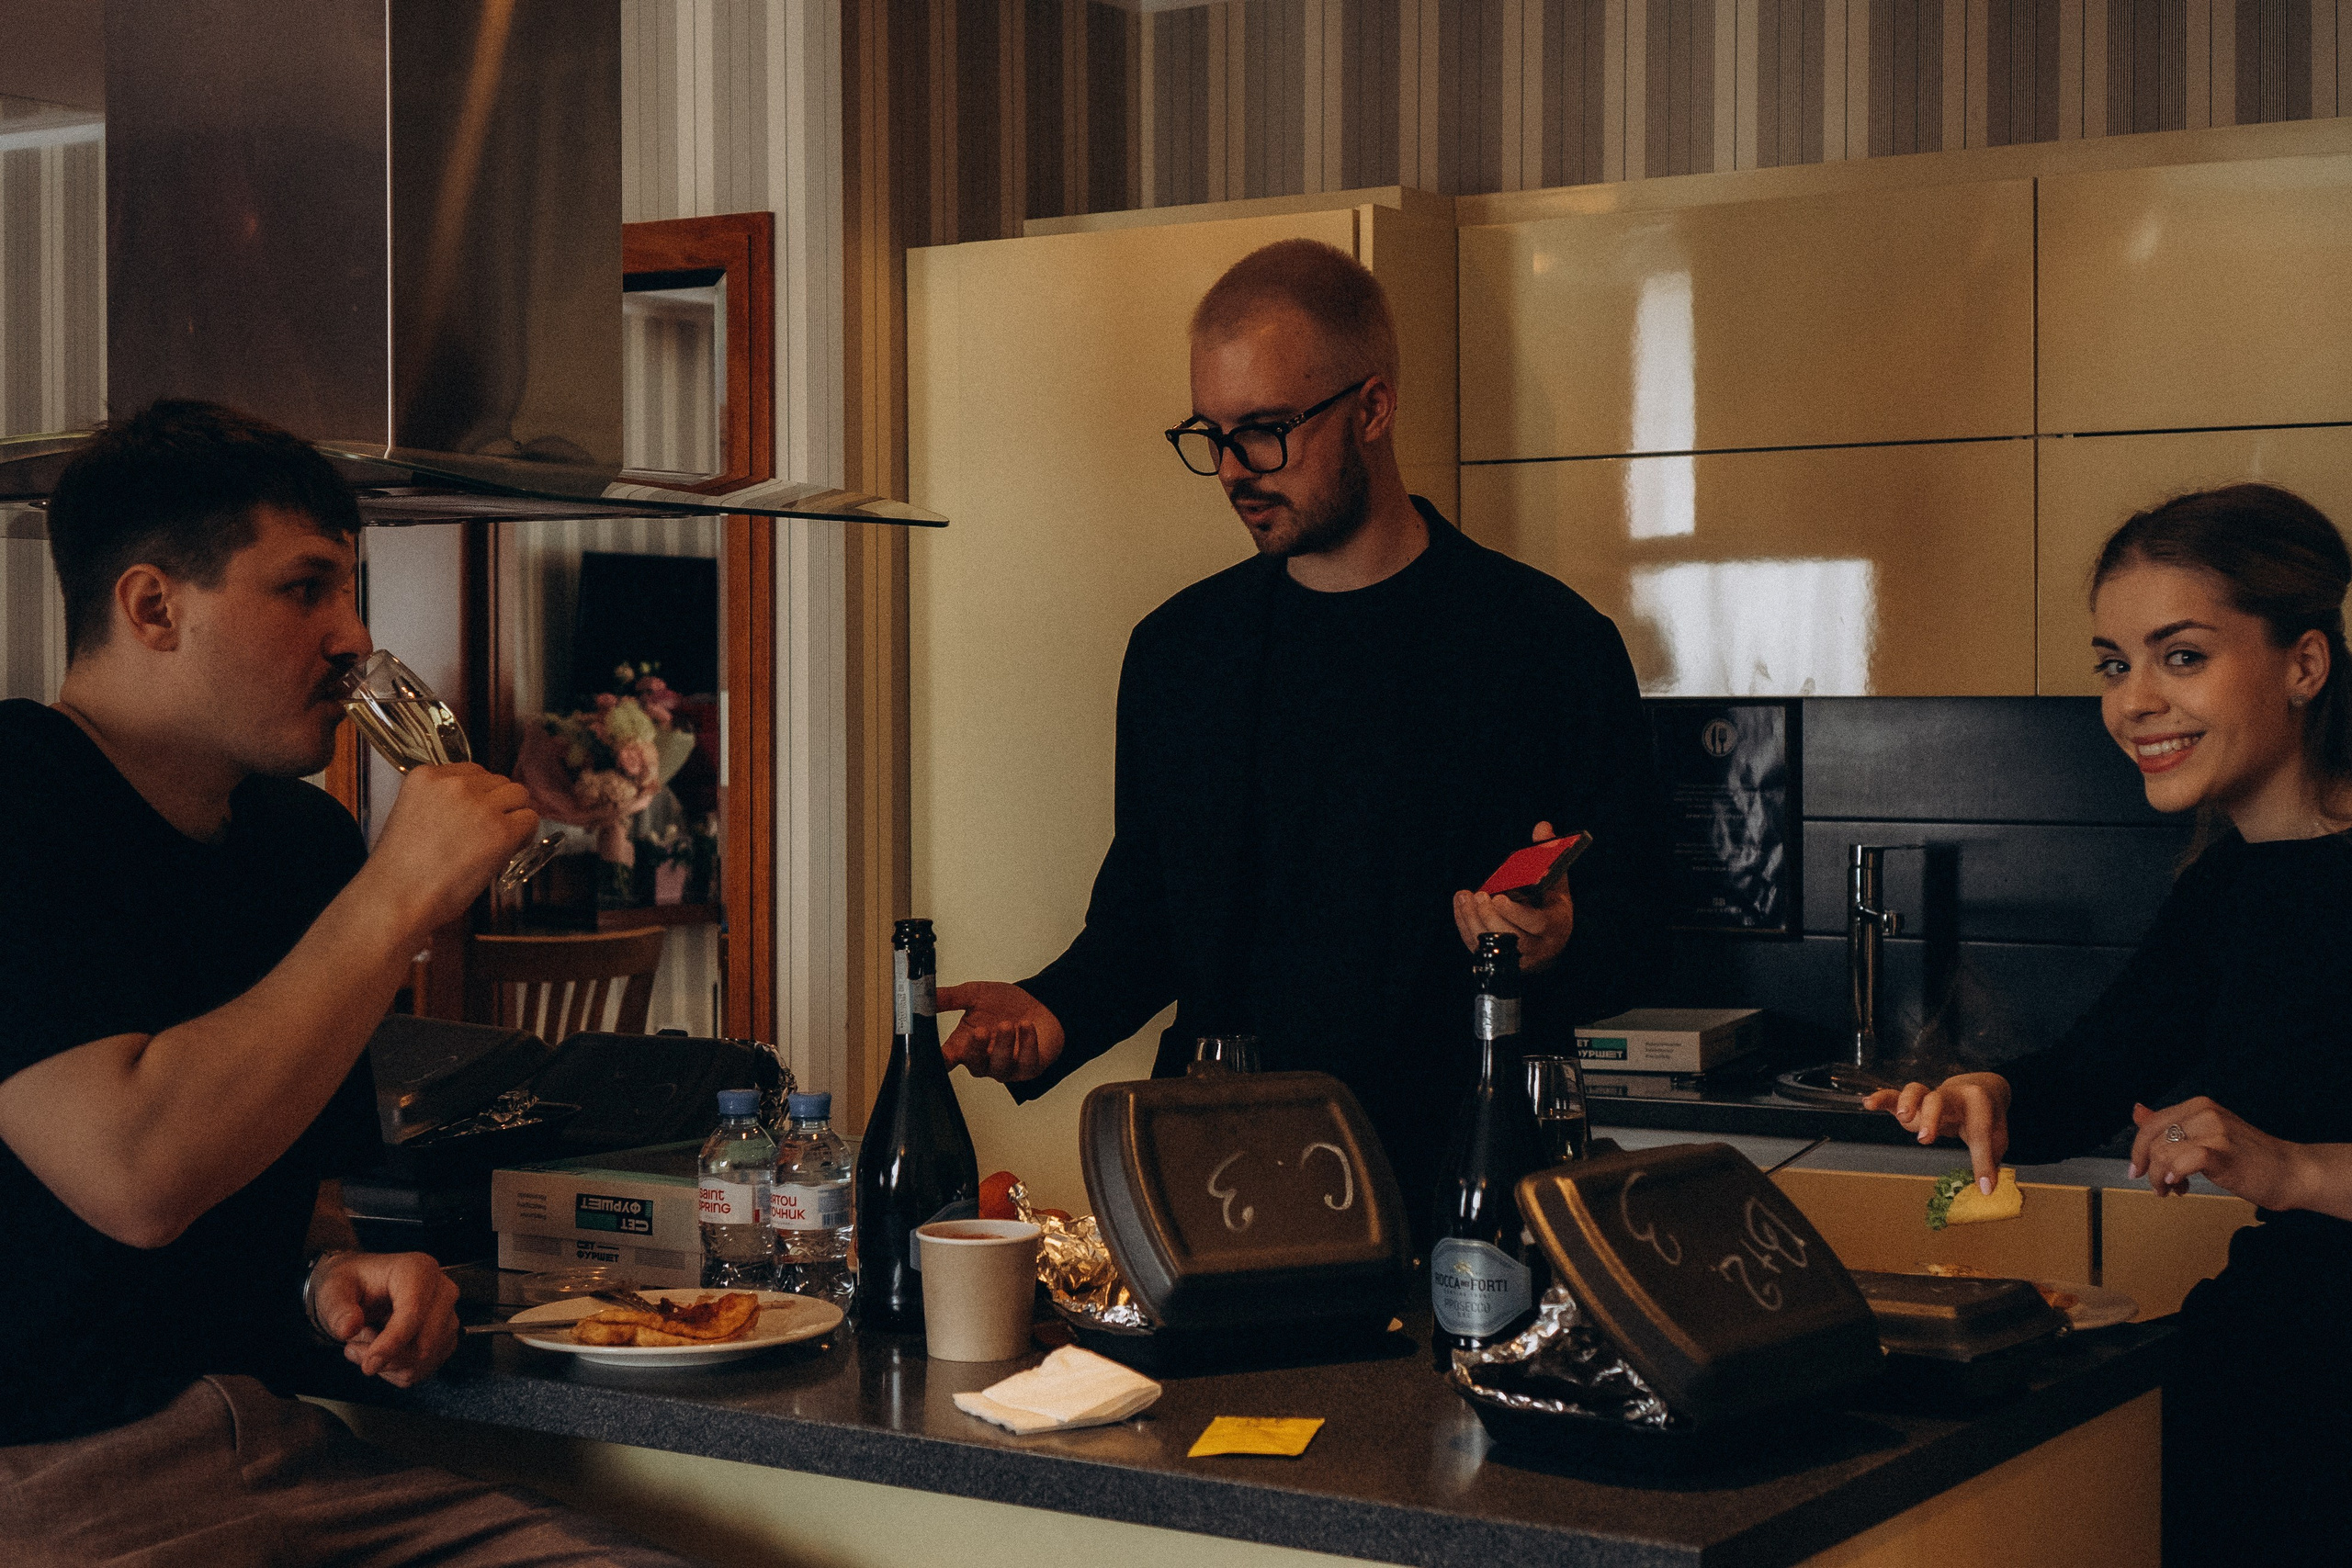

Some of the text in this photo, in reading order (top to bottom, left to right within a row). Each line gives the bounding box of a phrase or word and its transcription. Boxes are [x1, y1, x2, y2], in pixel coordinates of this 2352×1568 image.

[1577, 1039, 1589, 1047] ЕТ
[580, 1196, 642, 1214] ФУРШЕТ
[770, 1205, 806, 1220] ОЧНИК
[620, 1218, 650, 1232] СЕТ
[576, 1240, 595, 1251] СЕТ
[576, 1250, 619, 1263] ФУРШЕТ
[1435, 1272, 1461, 1290] ROCCA
[1471, 1279, 1508, 1292] FORTI
